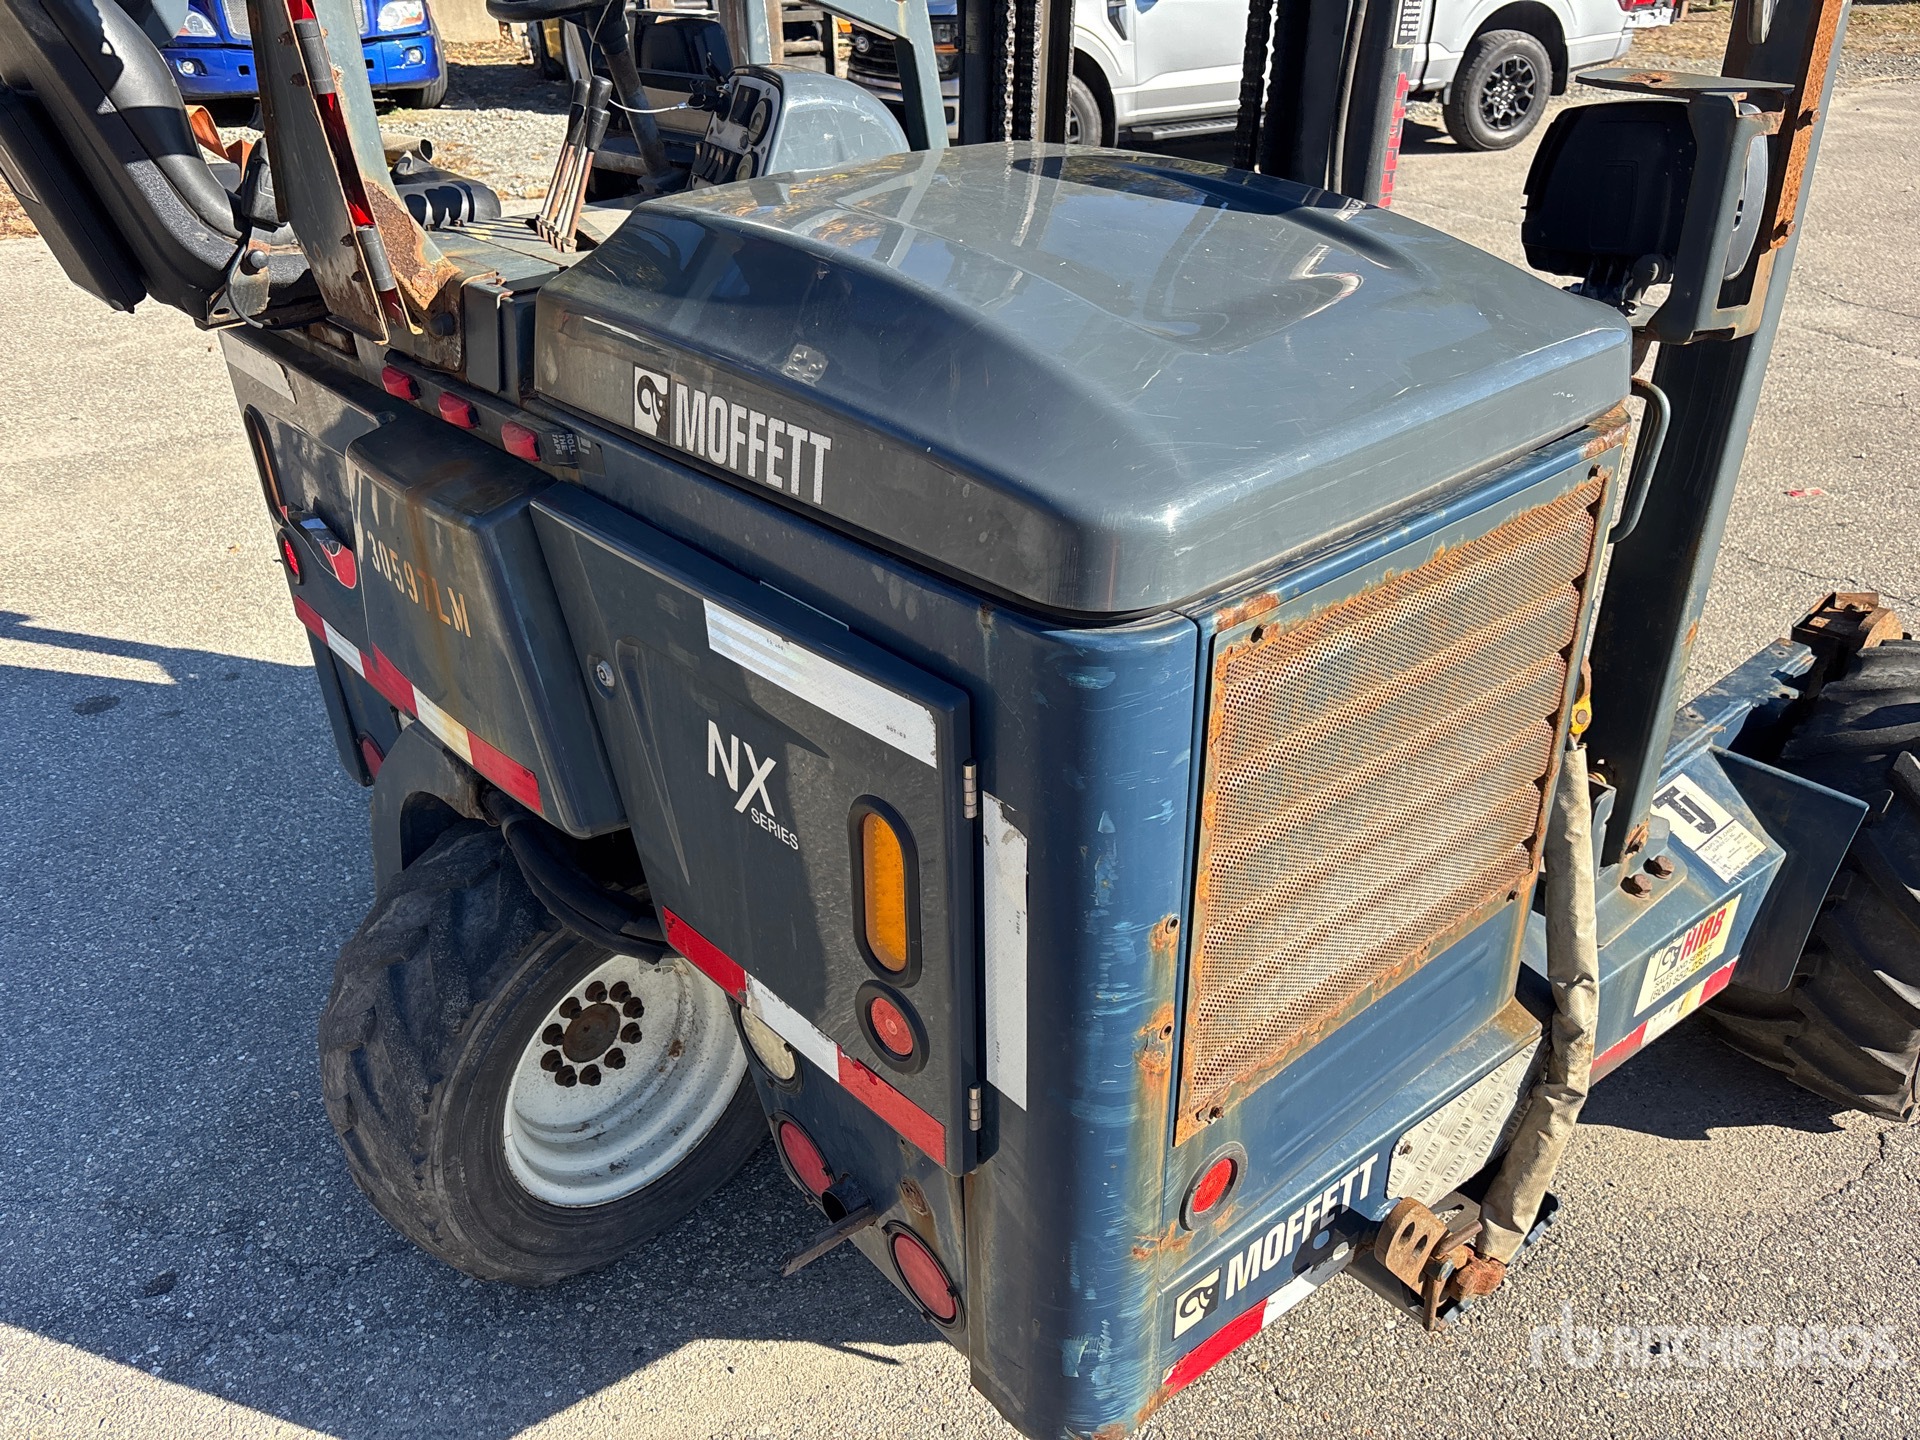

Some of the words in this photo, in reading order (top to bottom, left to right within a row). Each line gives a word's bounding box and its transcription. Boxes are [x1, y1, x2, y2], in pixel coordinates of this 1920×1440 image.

[552, 434, 563, 455] TAPE
[558, 434, 568, 451] THE
[566, 434, 577, 455] ROLL
[676, 382, 832, 505] MOFFETT
[367, 530, 471, 638] 30597LM
[708, 719, 777, 817] NX
[751, 807, 798, 850] SERIES
[1680, 907, 1726, 961] HIAB
[1225, 1152, 1379, 1300] MOFFETT
